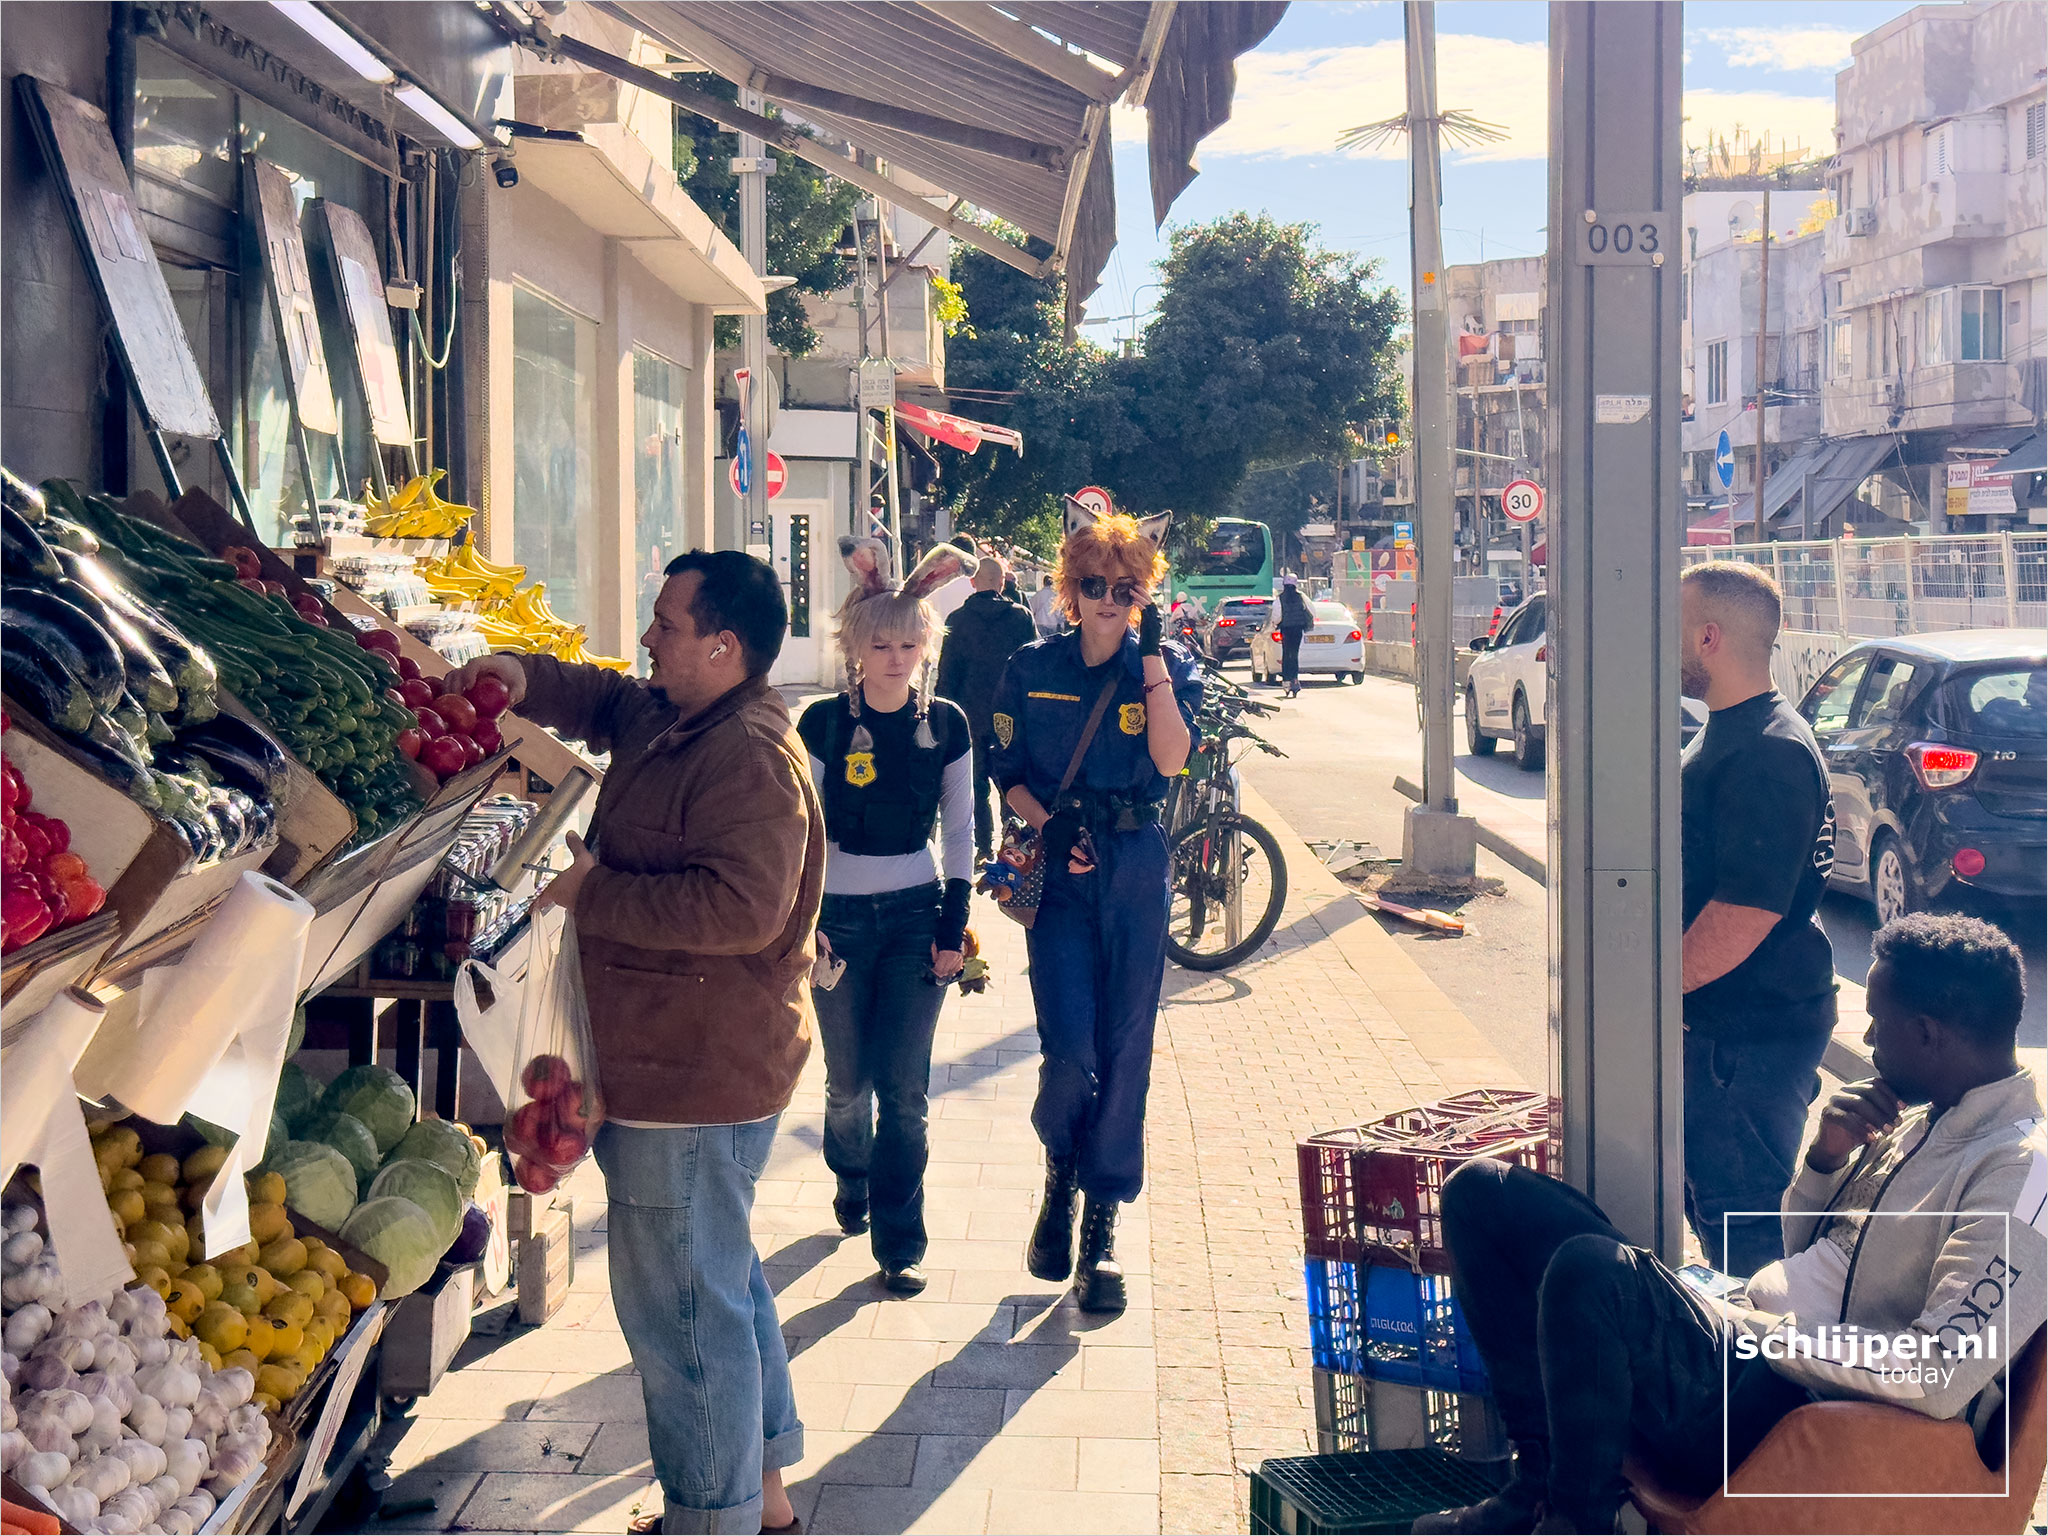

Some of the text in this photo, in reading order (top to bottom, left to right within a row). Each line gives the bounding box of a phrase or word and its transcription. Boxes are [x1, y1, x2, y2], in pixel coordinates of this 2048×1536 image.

[1588, 224, 1659, 254] 003
[1511, 494, 1532, 509] 30
[1201, 816, 1242, 825] KNDA
